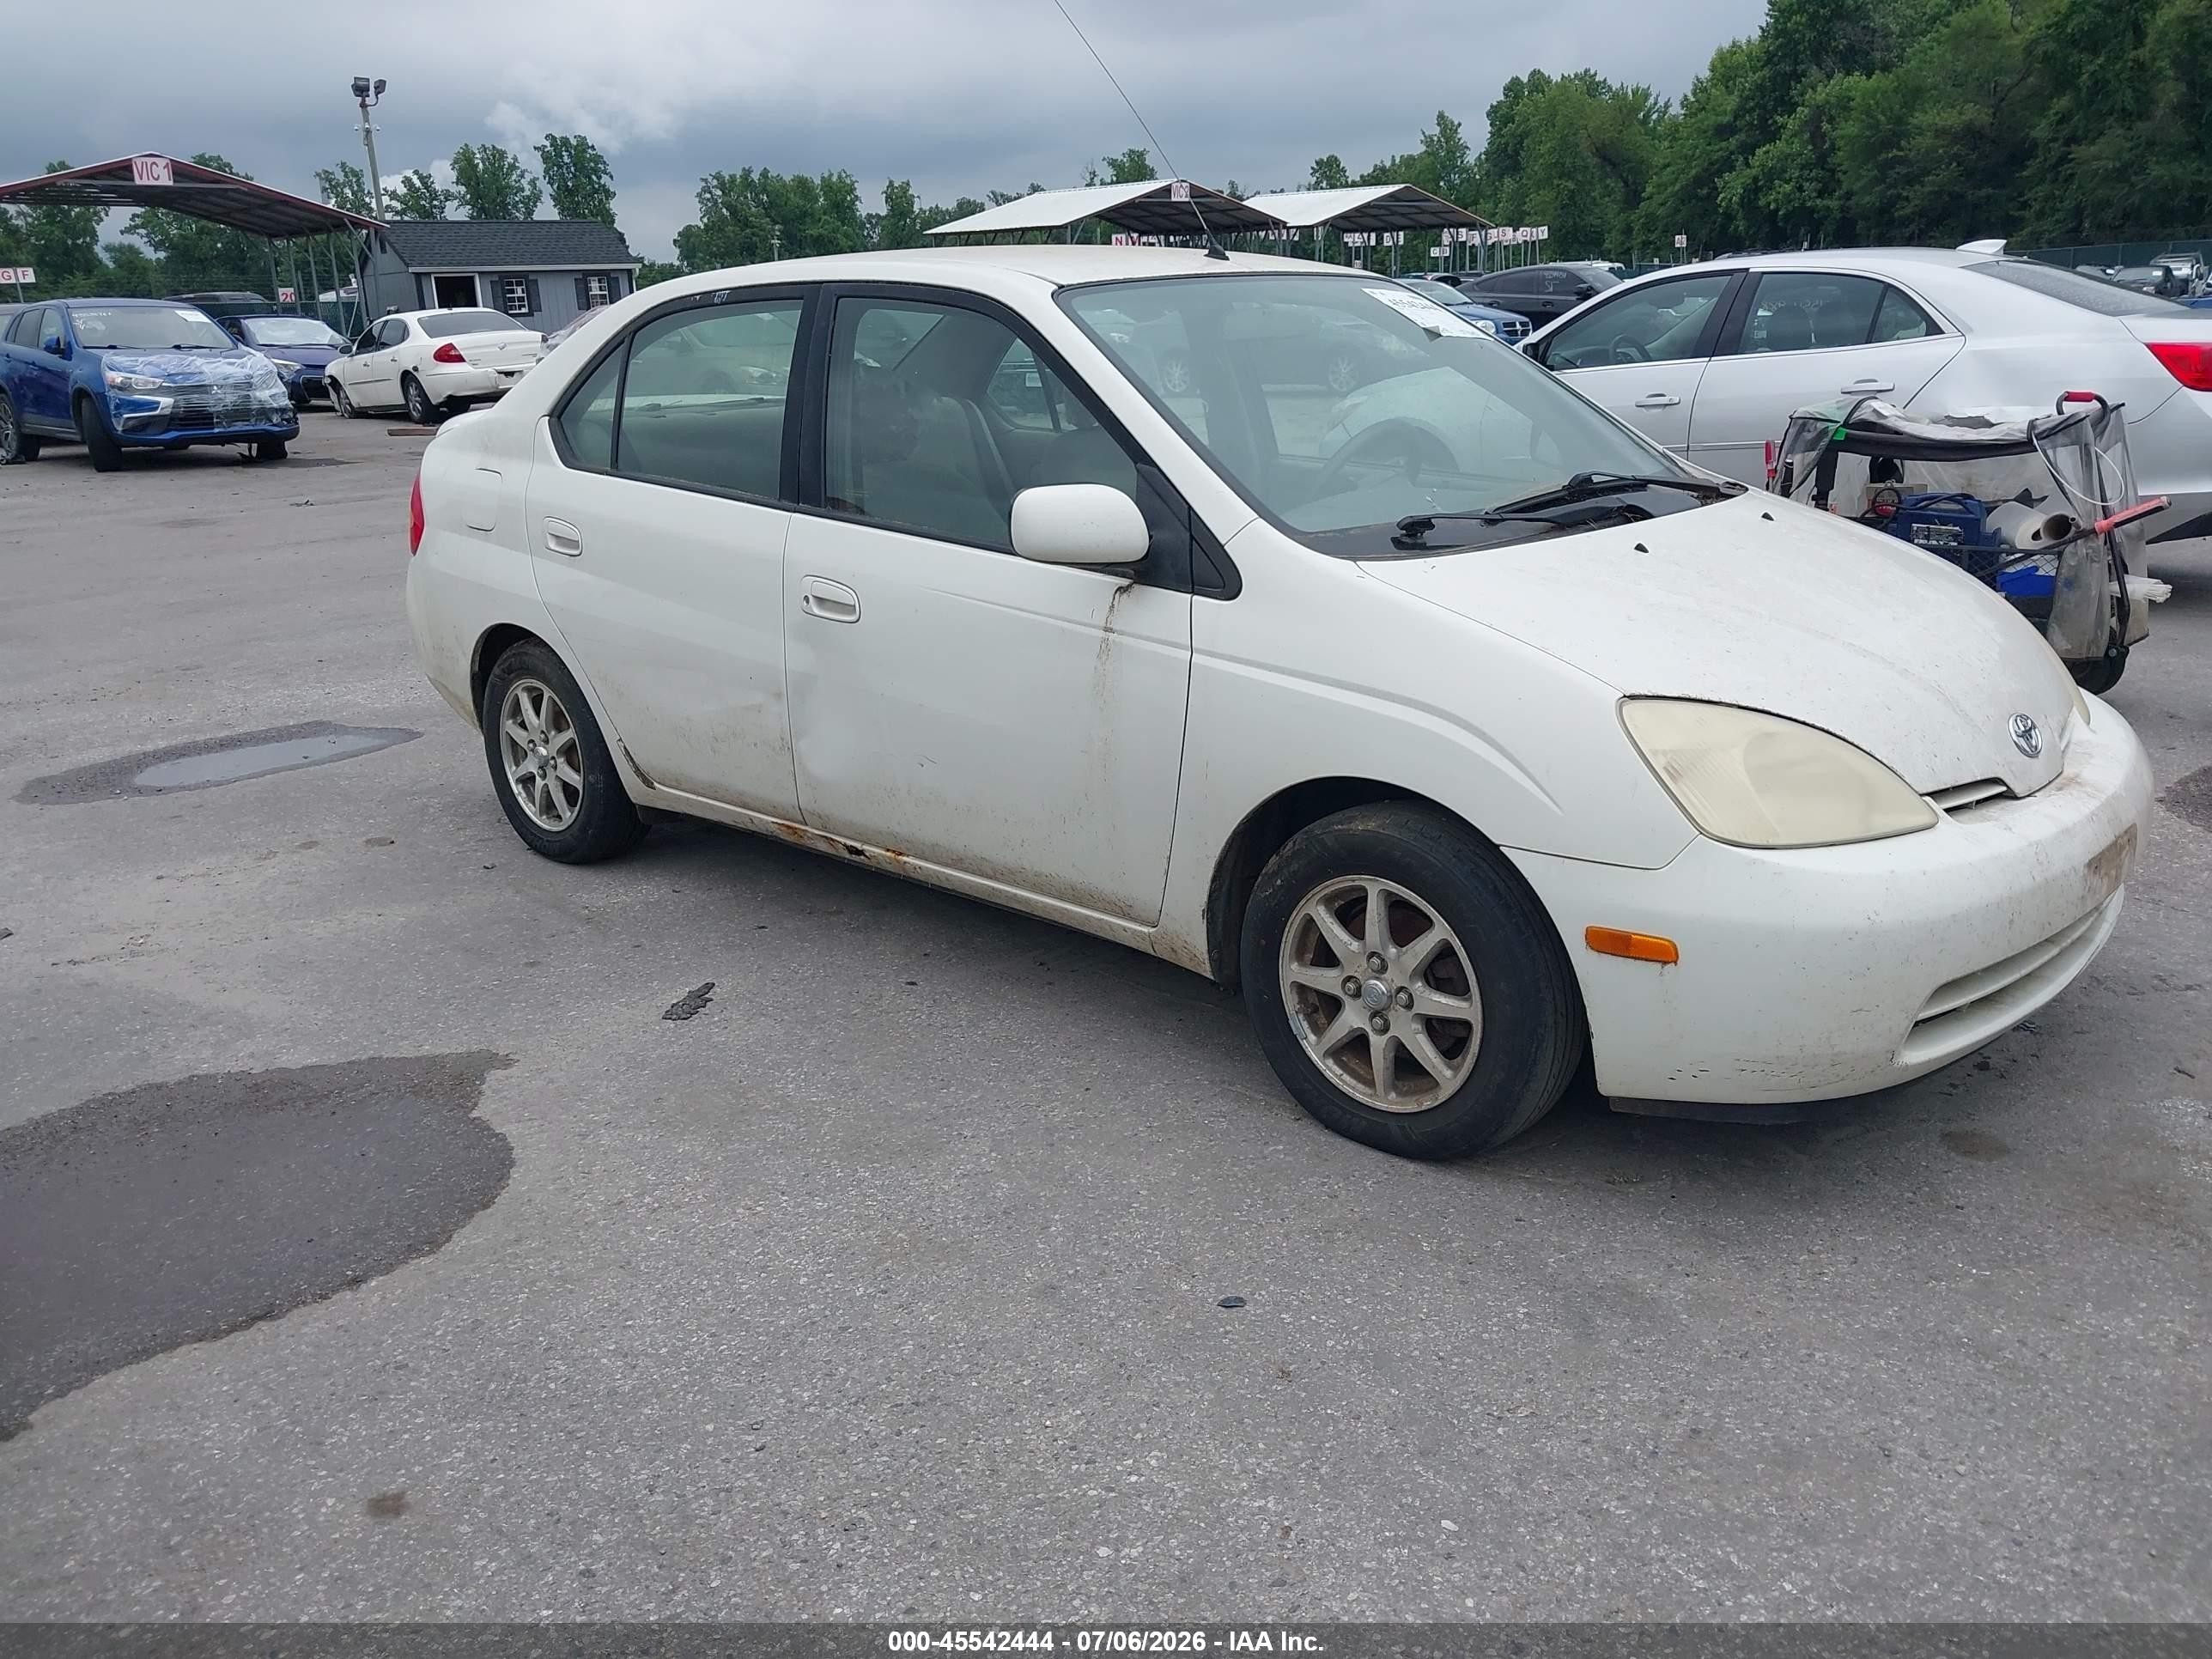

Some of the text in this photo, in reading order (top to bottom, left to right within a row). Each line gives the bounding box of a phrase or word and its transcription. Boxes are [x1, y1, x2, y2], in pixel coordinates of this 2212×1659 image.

[134, 161, 172, 181] VIC 1
[1, 270, 12, 281] G
[21, 270, 29, 280] F
